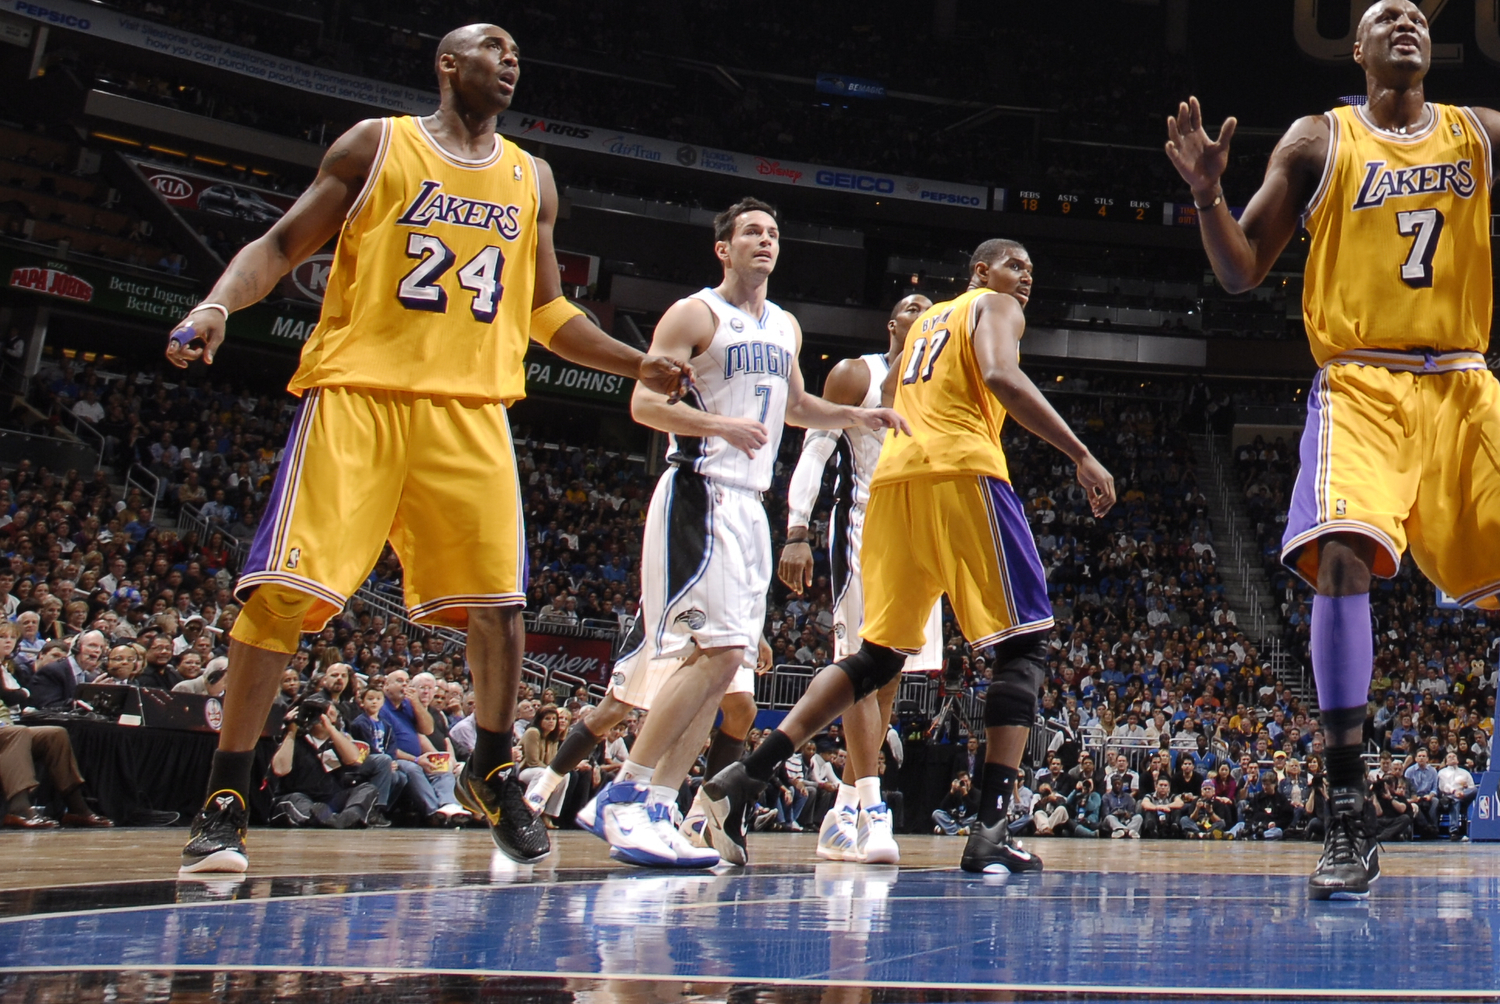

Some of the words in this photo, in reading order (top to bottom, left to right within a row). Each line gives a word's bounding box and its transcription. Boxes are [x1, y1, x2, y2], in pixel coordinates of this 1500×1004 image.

[14, 0, 92, 30] PEPSICO
[118, 17, 139, 34] Visit
[191, 34, 223, 54] Guest
[223, 43, 276, 69] Assistance
[279, 61, 294, 73] on
[294, 62, 311, 78] the
[313, 69, 374, 92] Promenade
[375, 81, 403, 97] Level
[404, 89, 415, 101] to
[146, 37, 170, 54] how
[171, 43, 192, 60] you
[194, 50, 216, 63] can
[218, 56, 265, 77] purchase
[267, 69, 313, 89] products
[314, 80, 337, 94] and
[338, 87, 379, 103] services
[520, 117, 591, 140] HARRIS
[700, 160, 739, 173] HOSPITAL
[701, 150, 735, 163] FLORIDA
[155, 178, 186, 197] KIA
[815, 169, 895, 195] GEICO
[1351, 159, 1478, 213] LAKERS
[394, 180, 522, 242] LAKERS
[921, 190, 980, 207] PEPSICO
[1020, 191, 1041, 200] REBS
[1058, 194, 1079, 203] ASTS
[1094, 197, 1114, 206] STLS
[1130, 200, 1151, 209] BLKS
[1021, 198, 1039, 212] 18
[1061, 202, 1071, 215] 9
[1097, 205, 1108, 217] 4
[1135, 208, 1145, 221] 2
[1396, 208, 1446, 290] 7
[9, 267, 47, 292] PAPA
[49, 271, 94, 303] JOHNS
[109, 275, 151, 297] Better
[398, 232, 506, 324] 24
[126, 296, 169, 316] Better
[902, 327, 951, 386] 17
[554, 366, 625, 396] JOHNS!
[754, 384, 773, 426] 7
